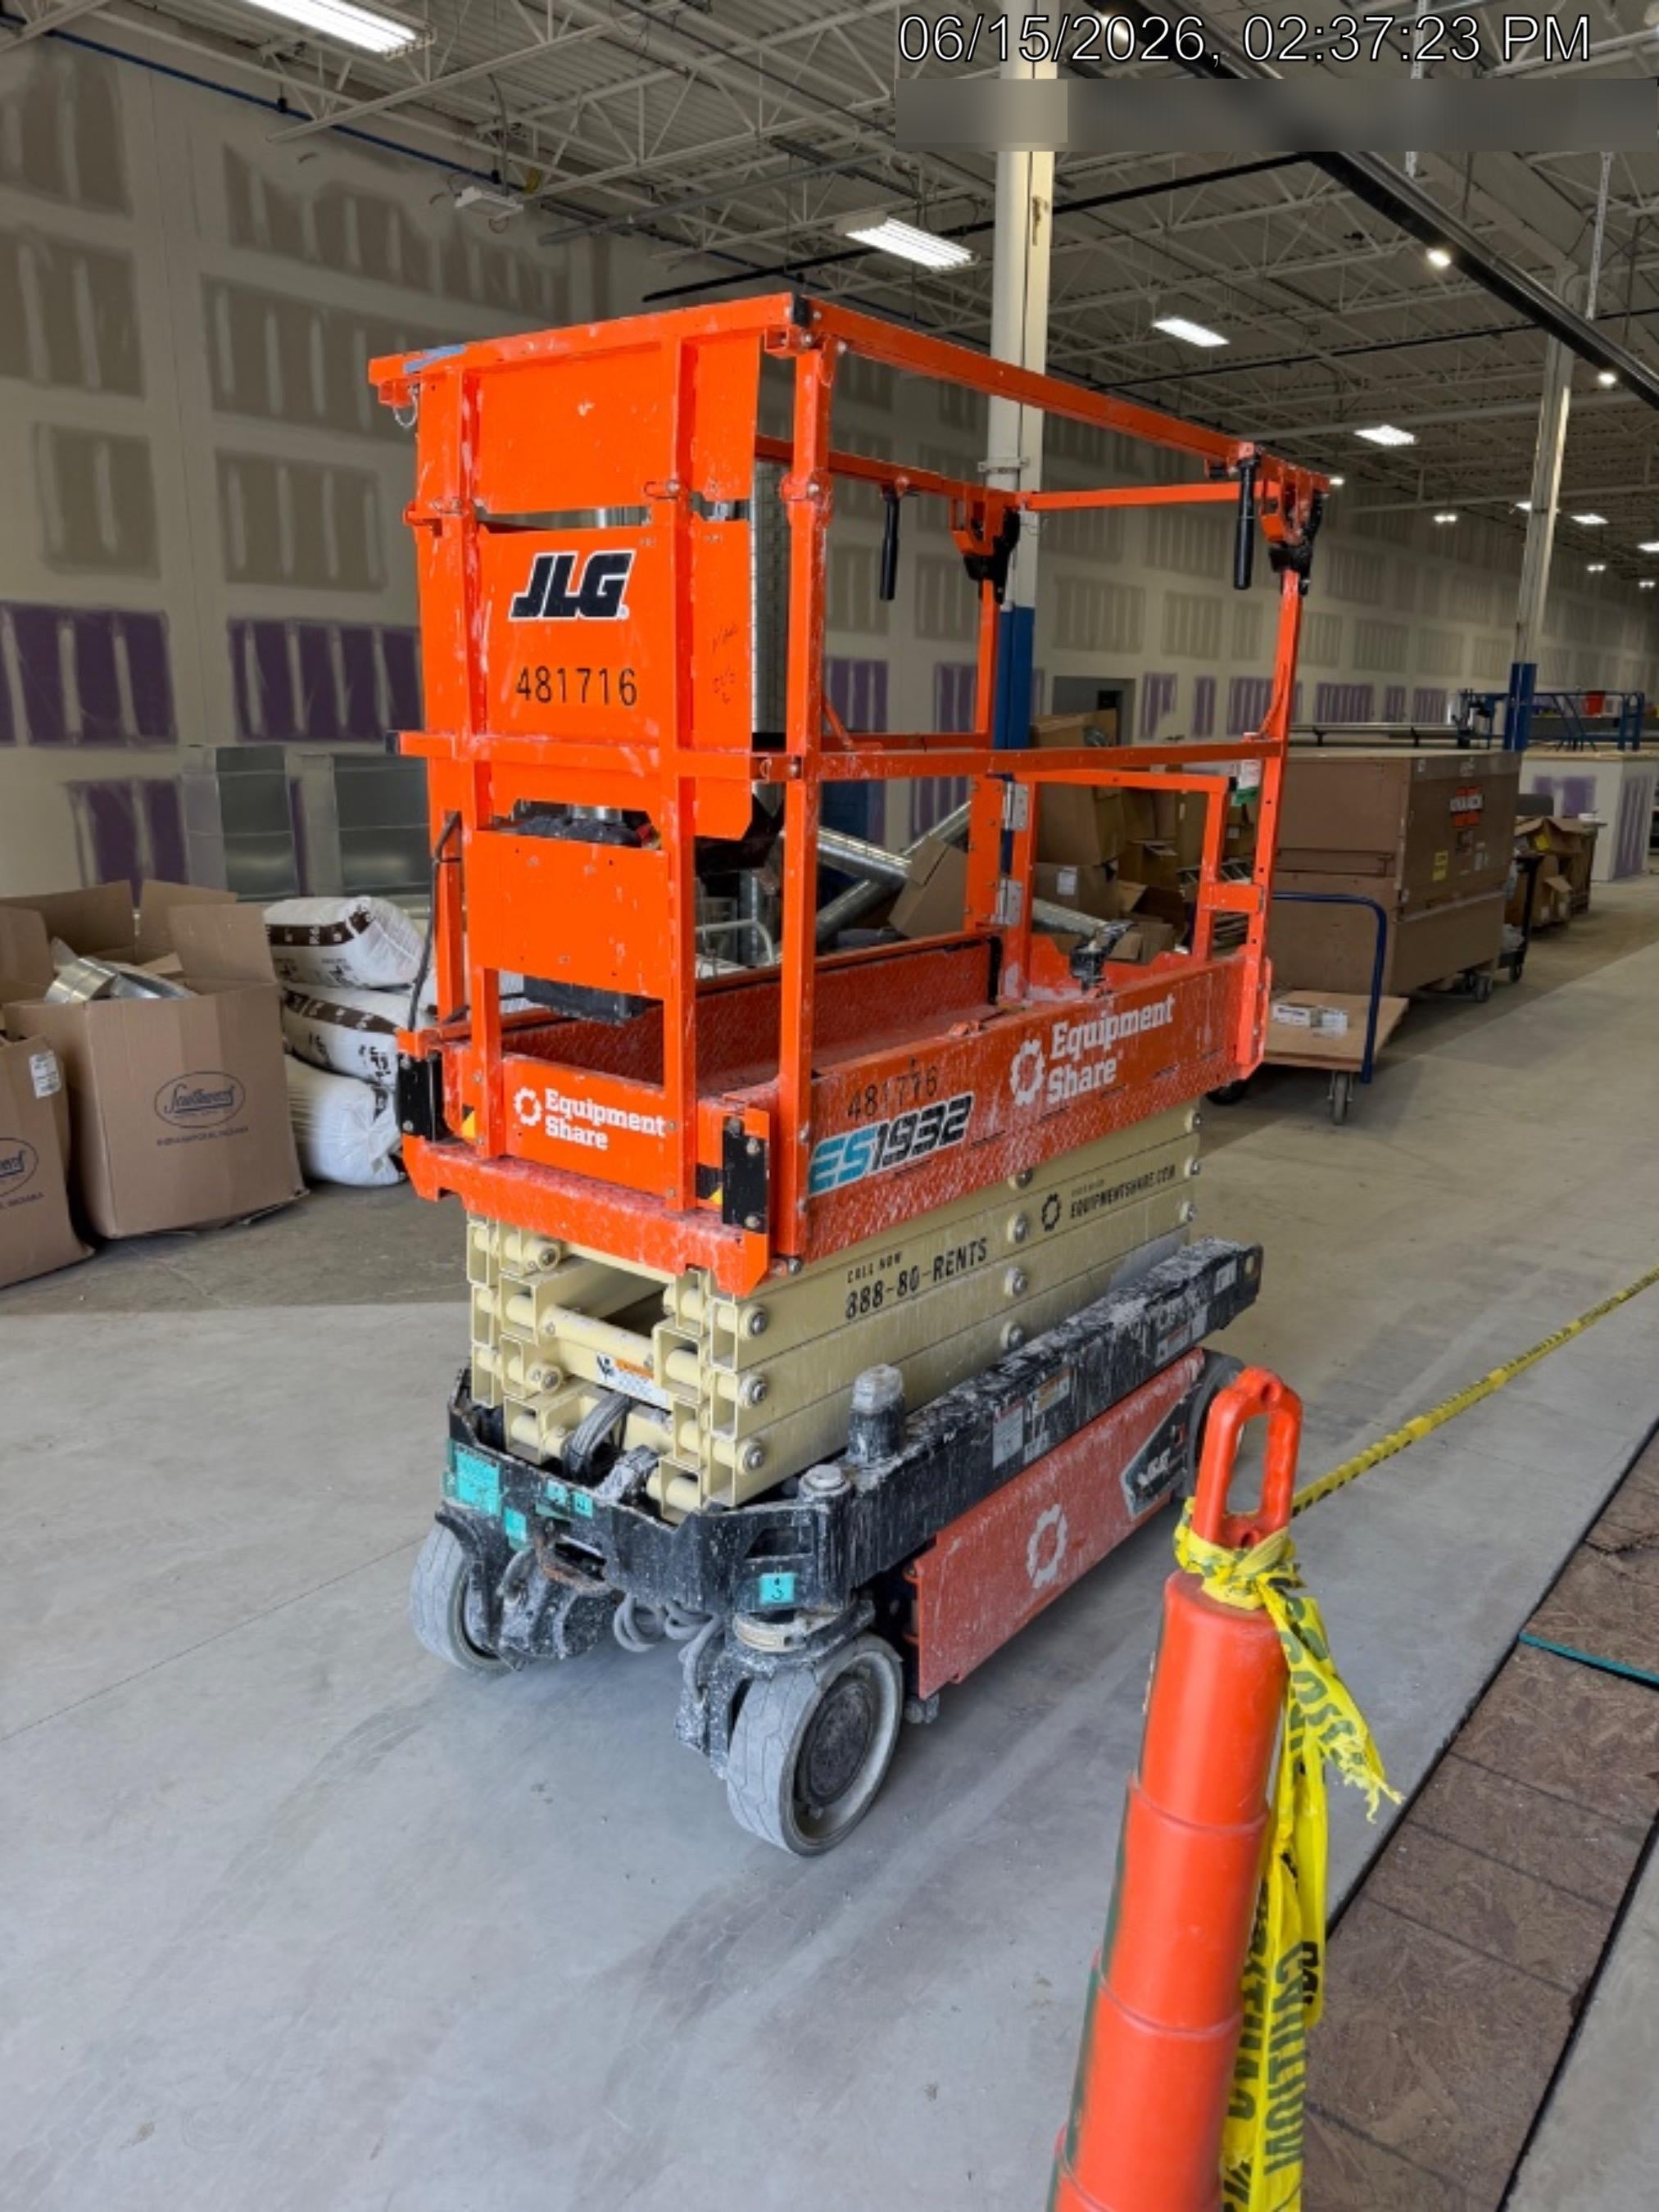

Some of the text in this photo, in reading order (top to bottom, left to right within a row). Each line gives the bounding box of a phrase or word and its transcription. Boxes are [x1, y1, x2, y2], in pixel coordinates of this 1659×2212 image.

[509, 549, 636, 621] JLG
[516, 664, 637, 706] 481716
[1051, 993, 1176, 1060] Equipment
[1047, 1056, 1118, 1105] Share
[544, 1087, 667, 1138] Equipment
[544, 1115, 609, 1151] Share
[809, 1092, 974, 1197] ES1932
[845, 1238, 987, 1321] 888-80-RENTS
[880, 1251, 903, 1271] NOW
